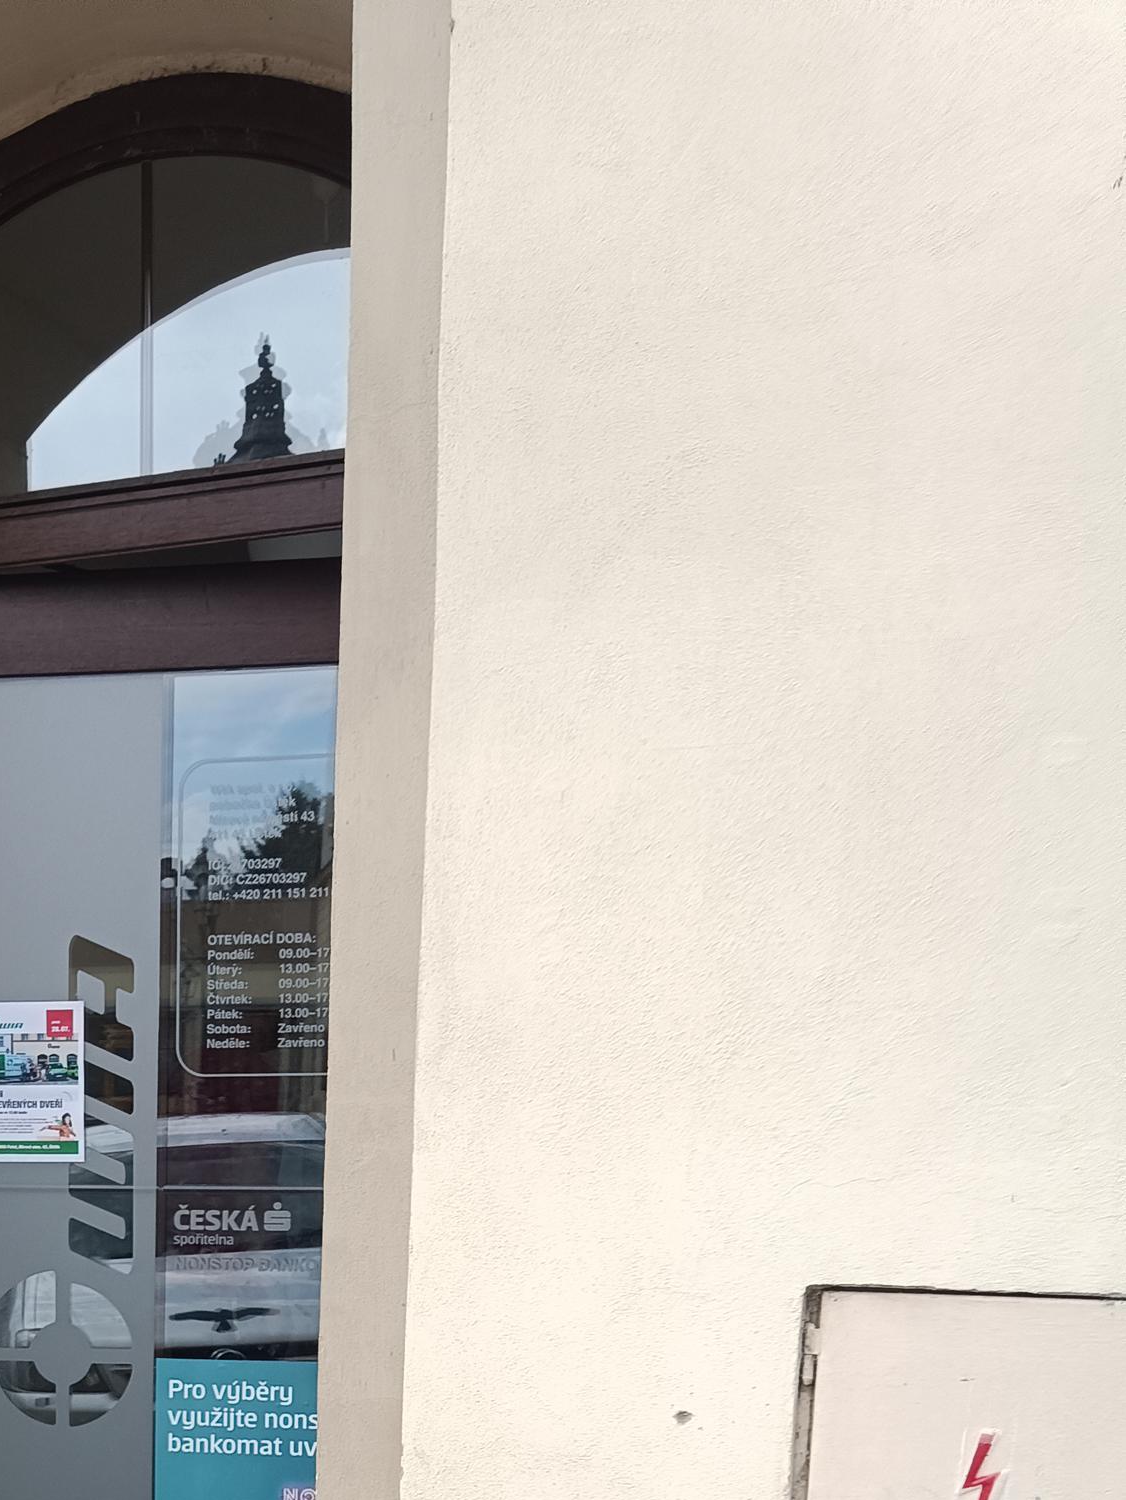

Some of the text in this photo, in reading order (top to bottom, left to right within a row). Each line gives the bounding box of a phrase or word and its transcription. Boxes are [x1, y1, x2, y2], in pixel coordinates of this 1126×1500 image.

[300, 811, 315, 822] 43
[236, 872, 307, 885] CZ26703297
[208, 886, 329, 901] tel.: +420 211 151 211
[207, 931, 316, 946] OTEVÍRACÍ DOBA:
[207, 948, 254, 960] Pondělí:
[207, 963, 242, 977] Úterý:
[206, 979, 248, 990] Středa:
[206, 993, 252, 1005] Čtvrtek:
[206, 1008, 243, 1020] Pátek:
[206, 1022, 325, 1035] Sobota: Zavřeno
[206, 1036, 325, 1049] Neděle: Zavřeno
[40, 1098, 63, 1109] DVEŘÍ
[174, 1204, 259, 1232] ČESKÁ
[173, 1233, 235, 1246] spořitelna
[176, 1256, 255, 1273] NONSTOP
[168, 1379, 293, 1406] Pro výběry
[168, 1406, 318, 1431] využijte nons
[168, 1433, 282, 1456] bankomat
